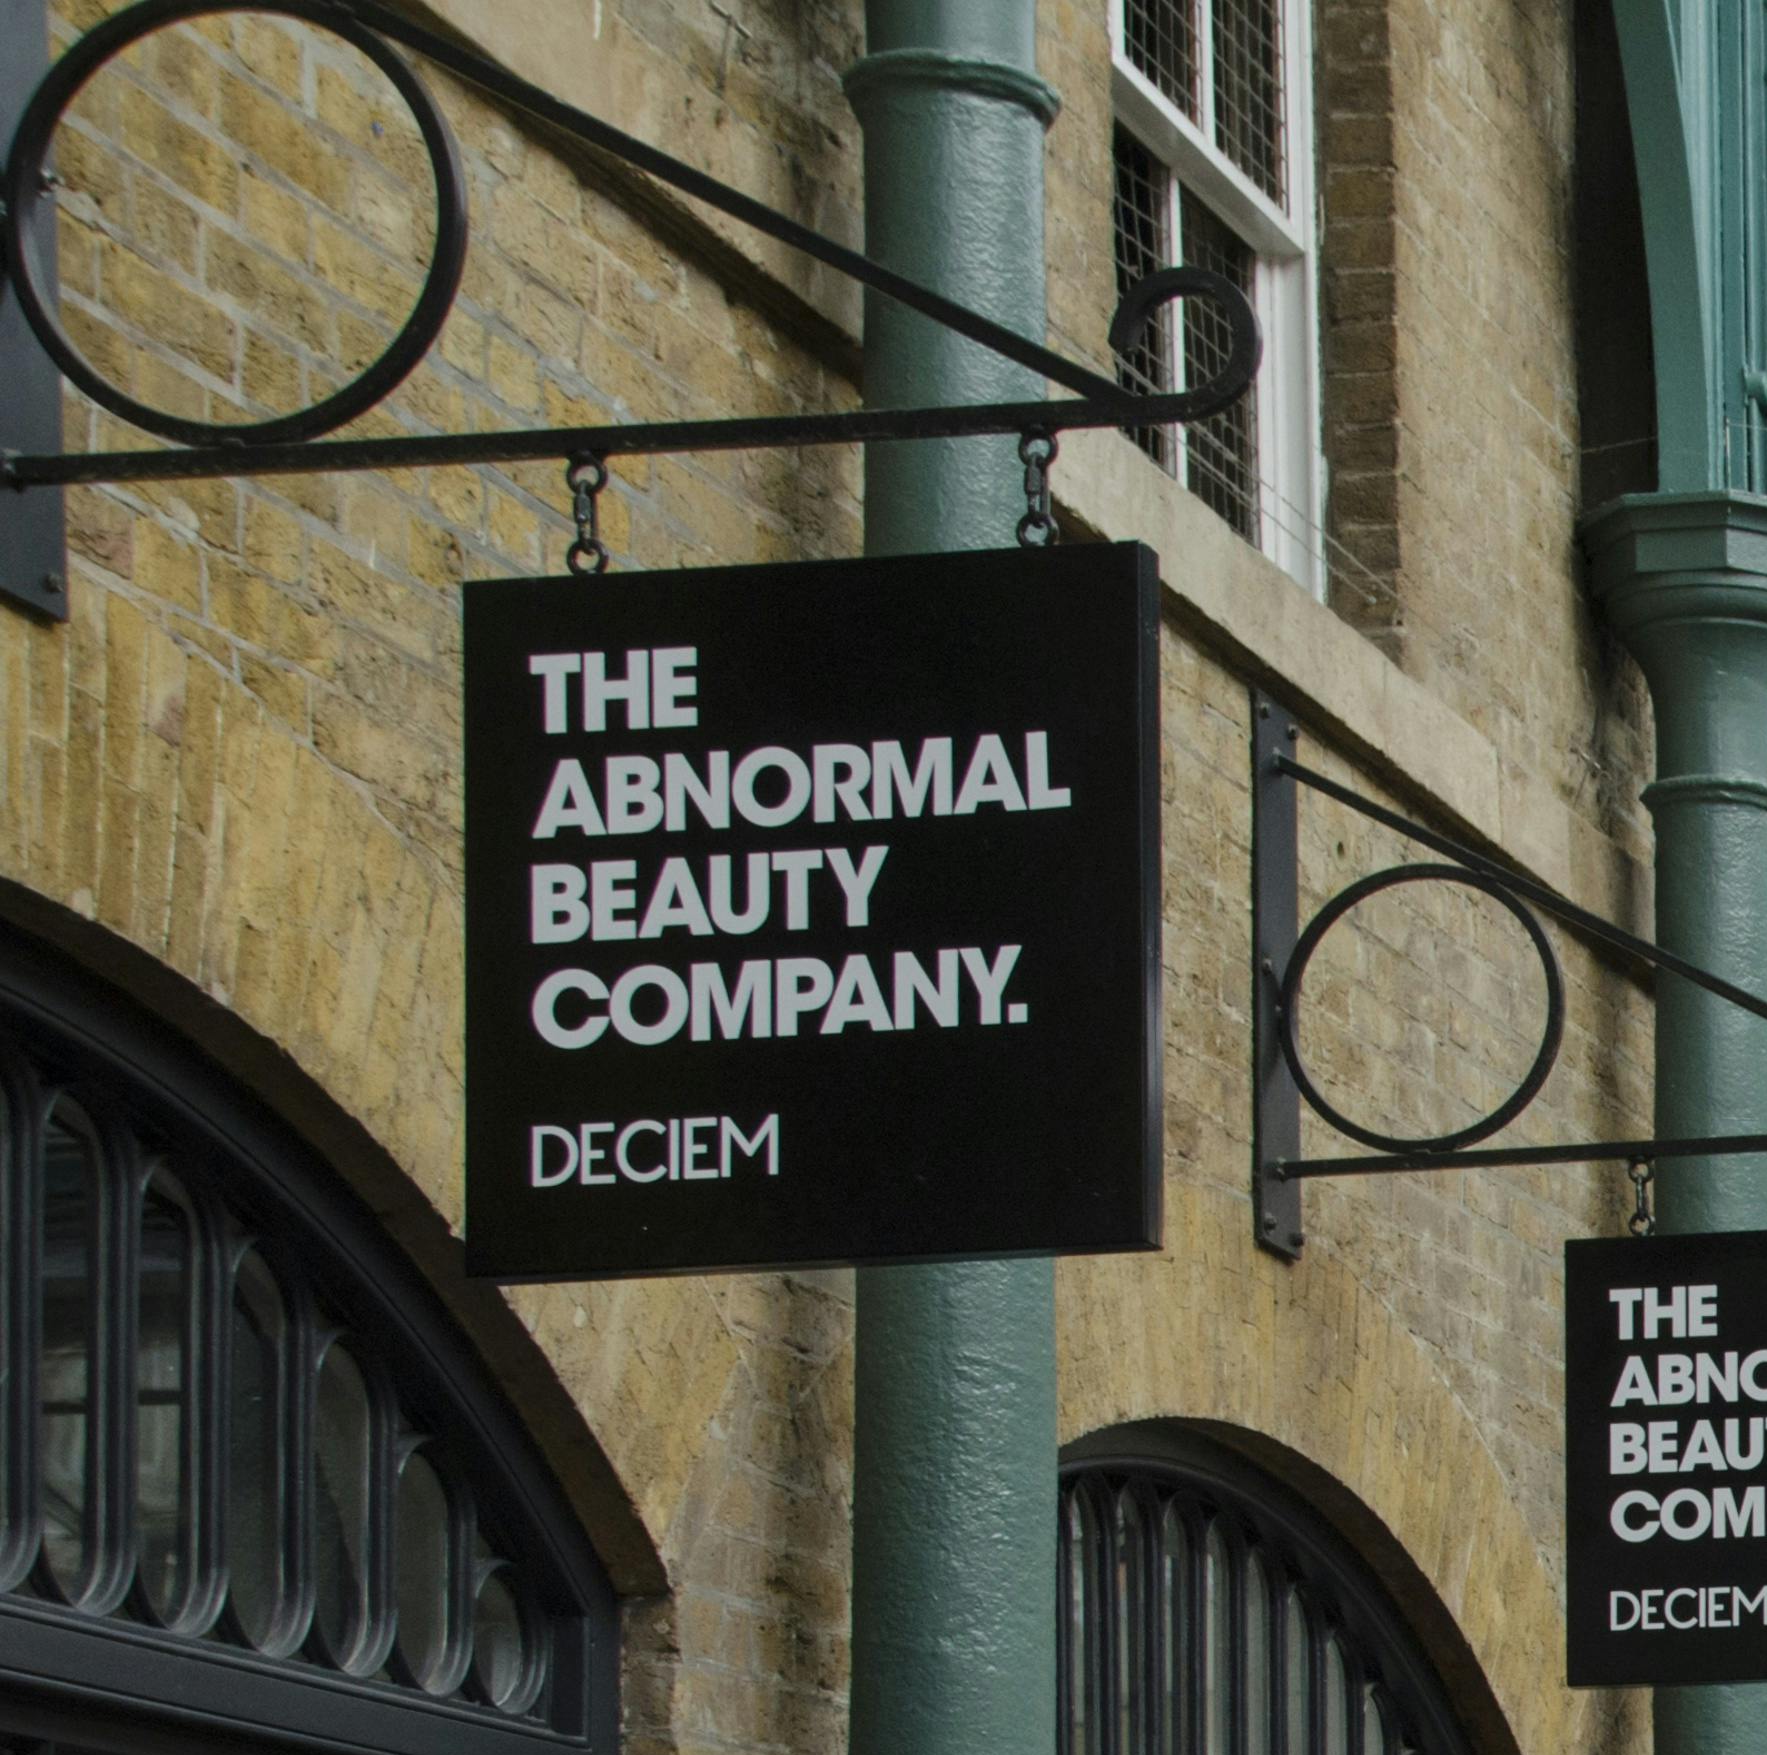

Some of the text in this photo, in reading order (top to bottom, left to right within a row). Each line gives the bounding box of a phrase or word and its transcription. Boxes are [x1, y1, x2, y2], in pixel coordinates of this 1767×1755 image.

[529, 646, 698, 734] THE
[532, 731, 1071, 839] ABNORMAL
[530, 845, 889, 944] BEAUTY
[531, 944, 1029, 1049] COMPANY.
[530, 1113, 780, 1187] DECIEM
[1609, 1284, 1718, 1341] THE
